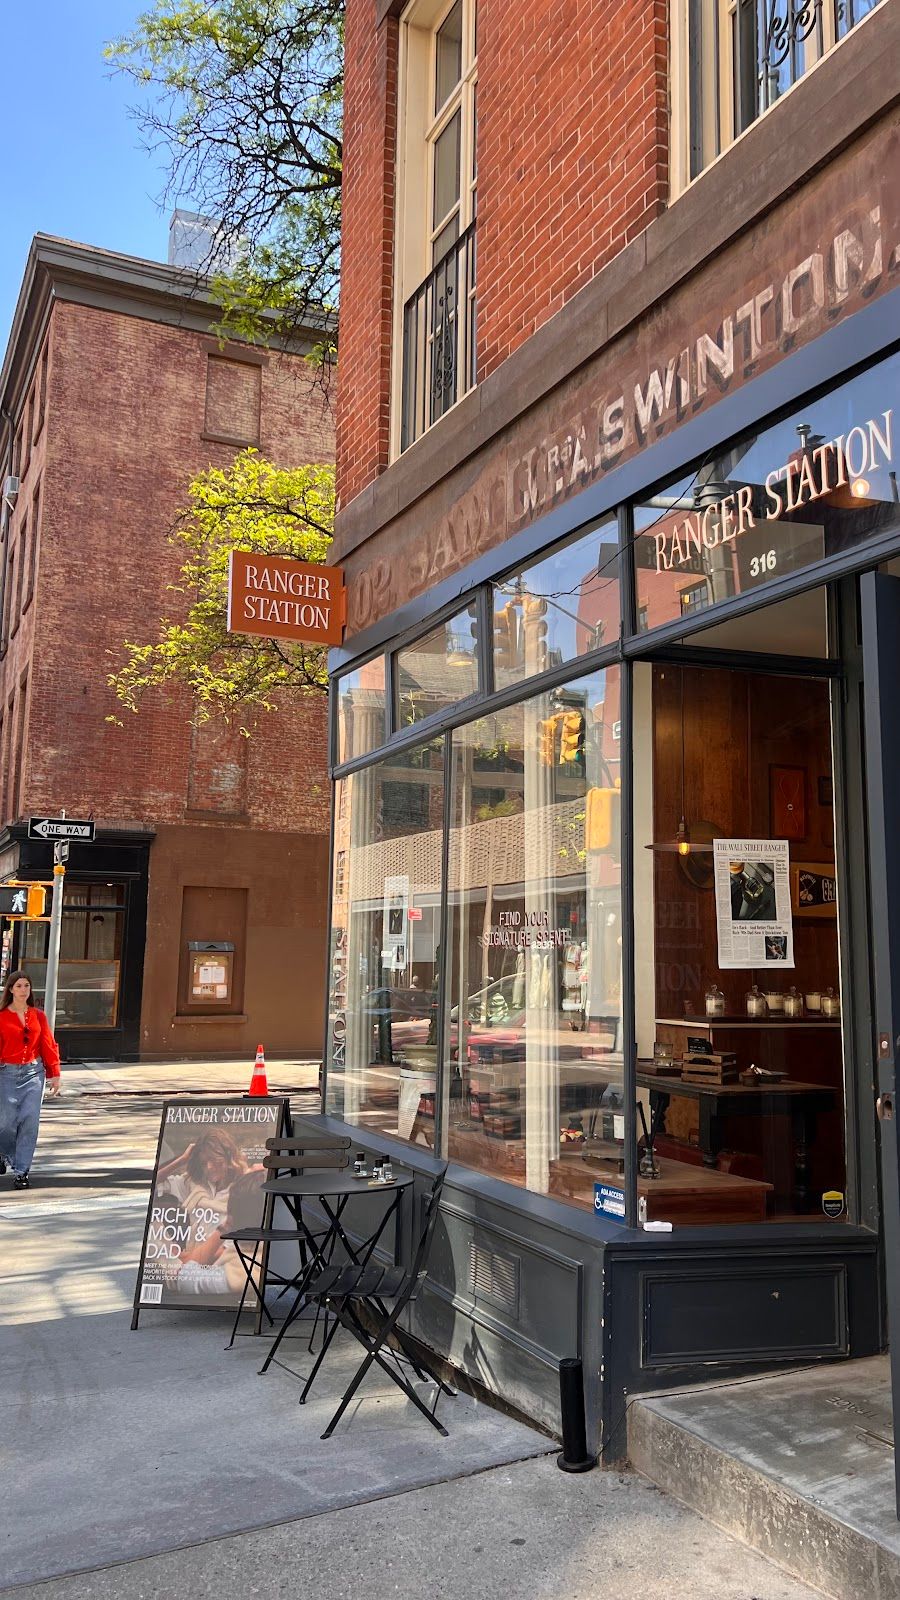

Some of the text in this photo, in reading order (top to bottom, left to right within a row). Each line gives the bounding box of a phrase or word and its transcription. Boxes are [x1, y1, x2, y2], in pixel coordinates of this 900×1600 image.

[653, 409, 893, 575] RANGER STATION
[750, 550, 777, 577] 316
[244, 564, 331, 601] RANGER
[244, 595, 331, 630] STATION
[41, 824, 86, 835] ONE WAY
[717, 843, 786, 852] THE WALL STREET RANGER
[499, 911, 549, 927] FIND YOUR
[483, 929, 567, 947] SIGNATURE SCENT
[166, 1106, 278, 1123] RANGER STATION
[608, 1190, 624, 1201] ACCESS
[150, 1207, 188, 1223] RICH
[148, 1225, 207, 1242] MOM &
[145, 1243, 182, 1259] DAD
